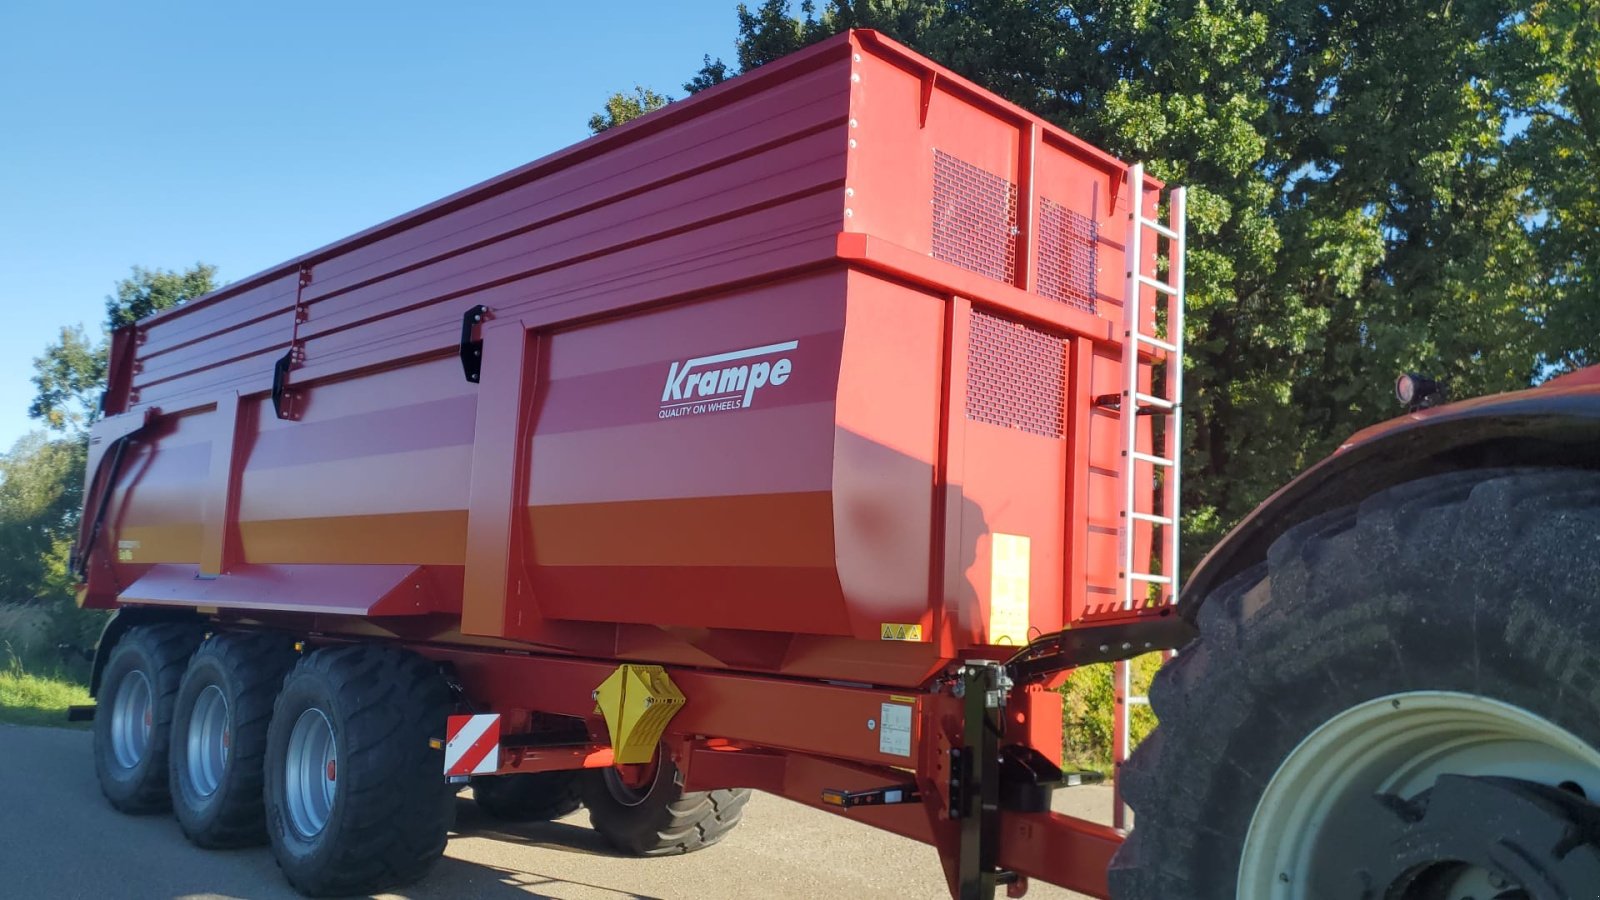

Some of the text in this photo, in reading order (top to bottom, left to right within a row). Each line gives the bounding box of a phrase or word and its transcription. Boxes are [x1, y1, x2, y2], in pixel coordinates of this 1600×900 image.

[661, 341, 798, 408] Krampe
[658, 400, 741, 419] QUALITY ON WHEELS
